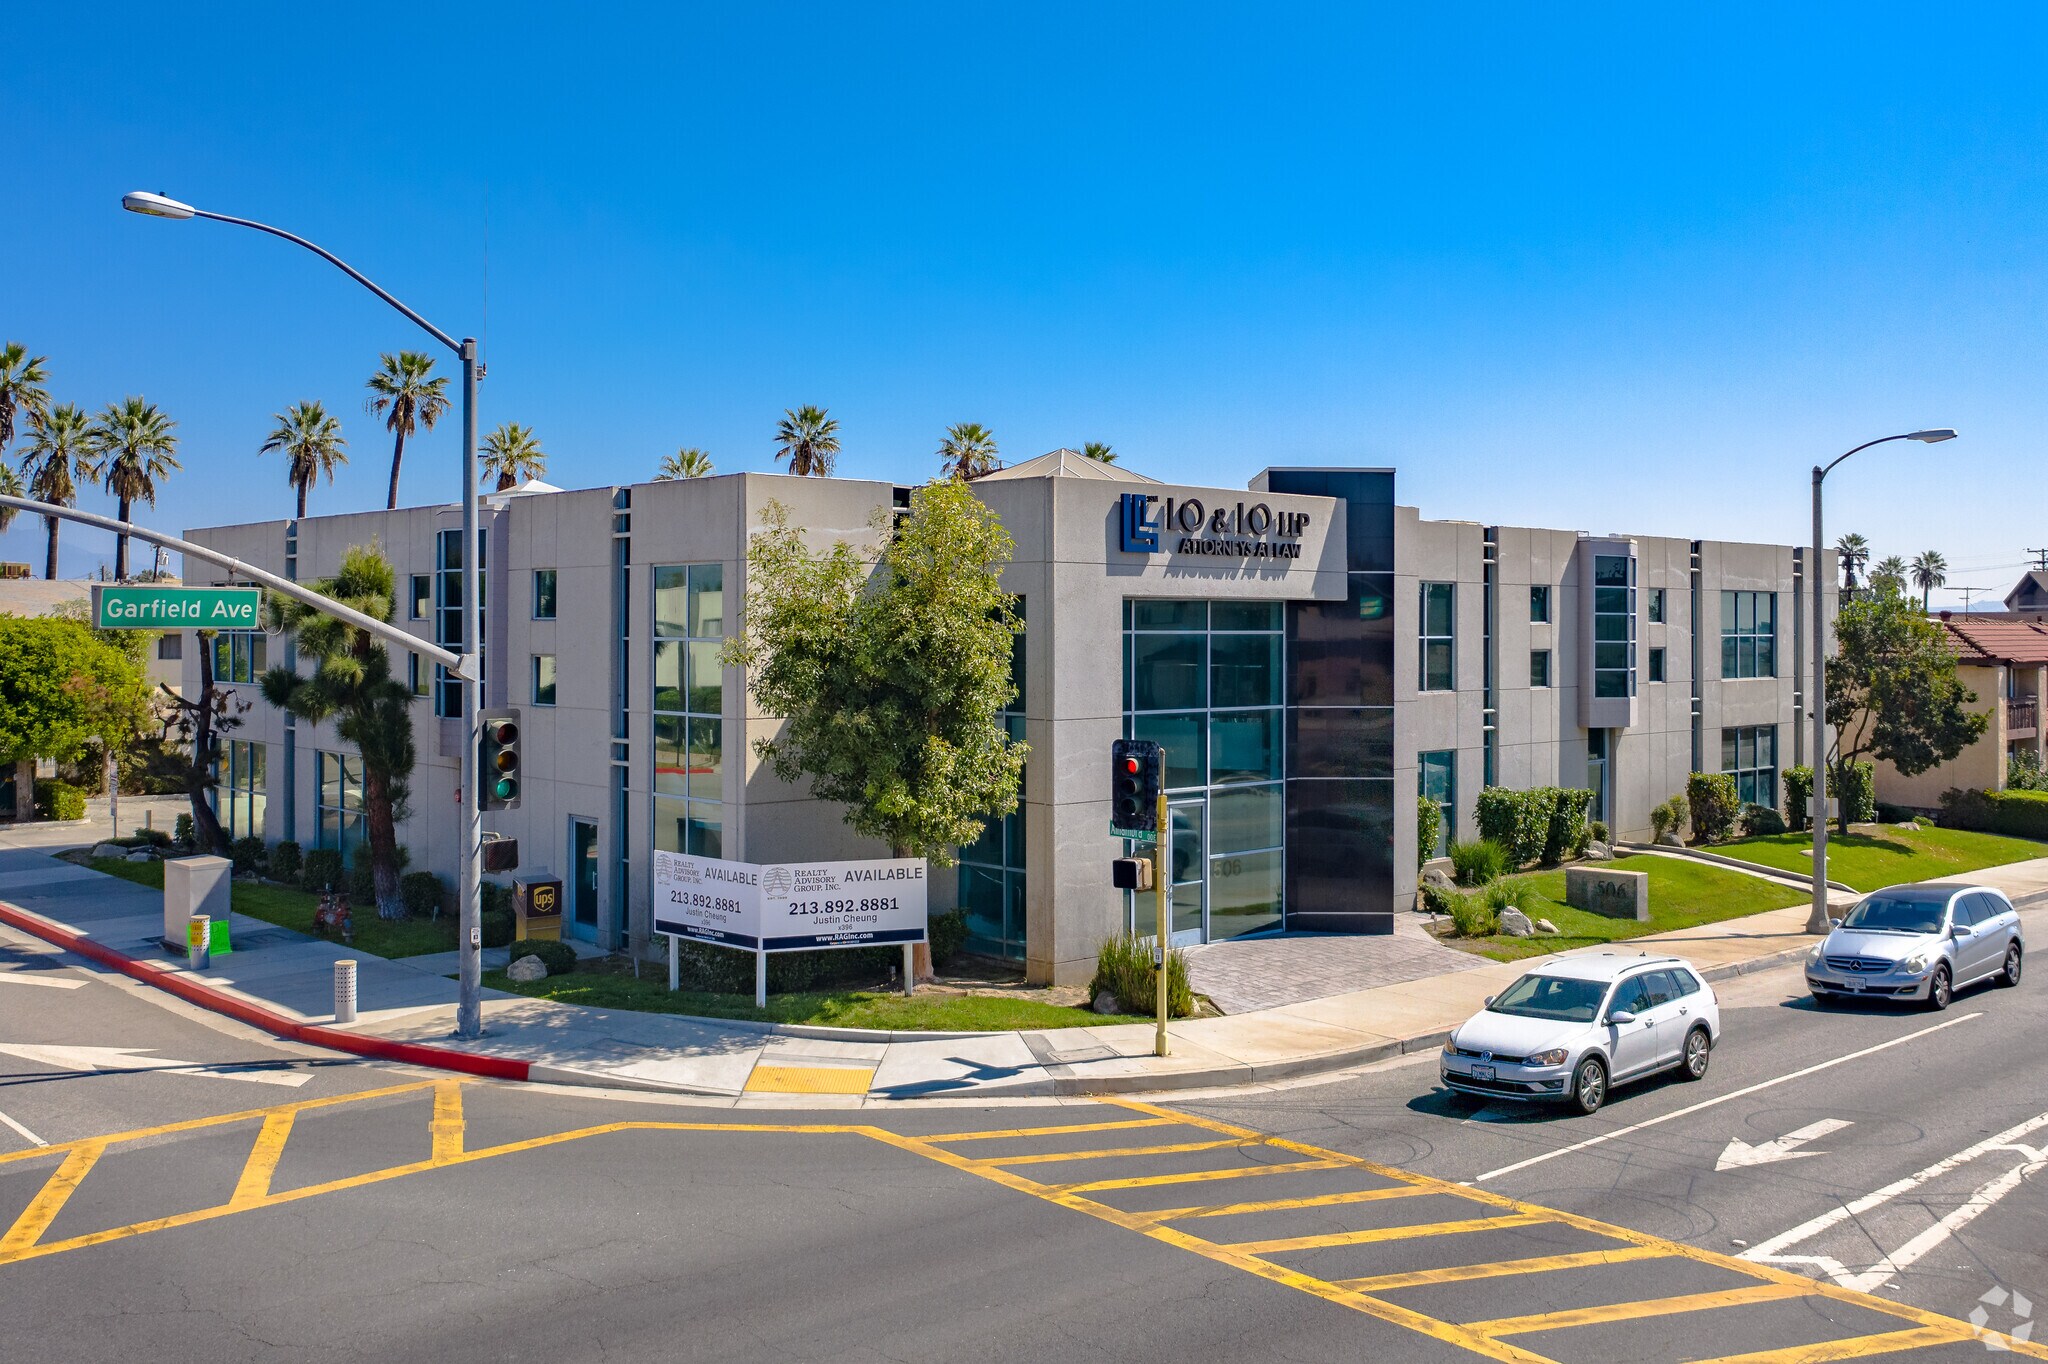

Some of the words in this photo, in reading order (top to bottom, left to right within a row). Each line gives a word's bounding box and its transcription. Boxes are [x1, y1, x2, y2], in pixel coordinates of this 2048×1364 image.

[1166, 498, 1205, 532] LO
[1212, 507, 1231, 533] &
[1236, 502, 1273, 535] LO
[1178, 538, 1252, 557] ATTORNEYS
[1273, 543, 1302, 558] LAW
[107, 598, 201, 618] Garfield
[211, 599, 253, 618] Ave
[673, 859, 695, 869] REALTY
[673, 866, 700, 877] ADVISORY
[1212, 858, 1242, 879] 506
[704, 867, 758, 886] AVAILABLE
[794, 869, 828, 878] REALTY
[794, 876, 836, 885] ADVISORY
[844, 867, 923, 883] AVAILABLE
[825, 883, 841, 891] INC.
[535, 893, 553, 908] ups
[671, 890, 742, 914] 213.892.8881
[789, 897, 900, 916] 213.892.8881
[685, 907, 703, 917] Justin
[704, 910, 727, 924] Cheung
[813, 915, 841, 925] Justin
[843, 914, 878, 924] Cheung
